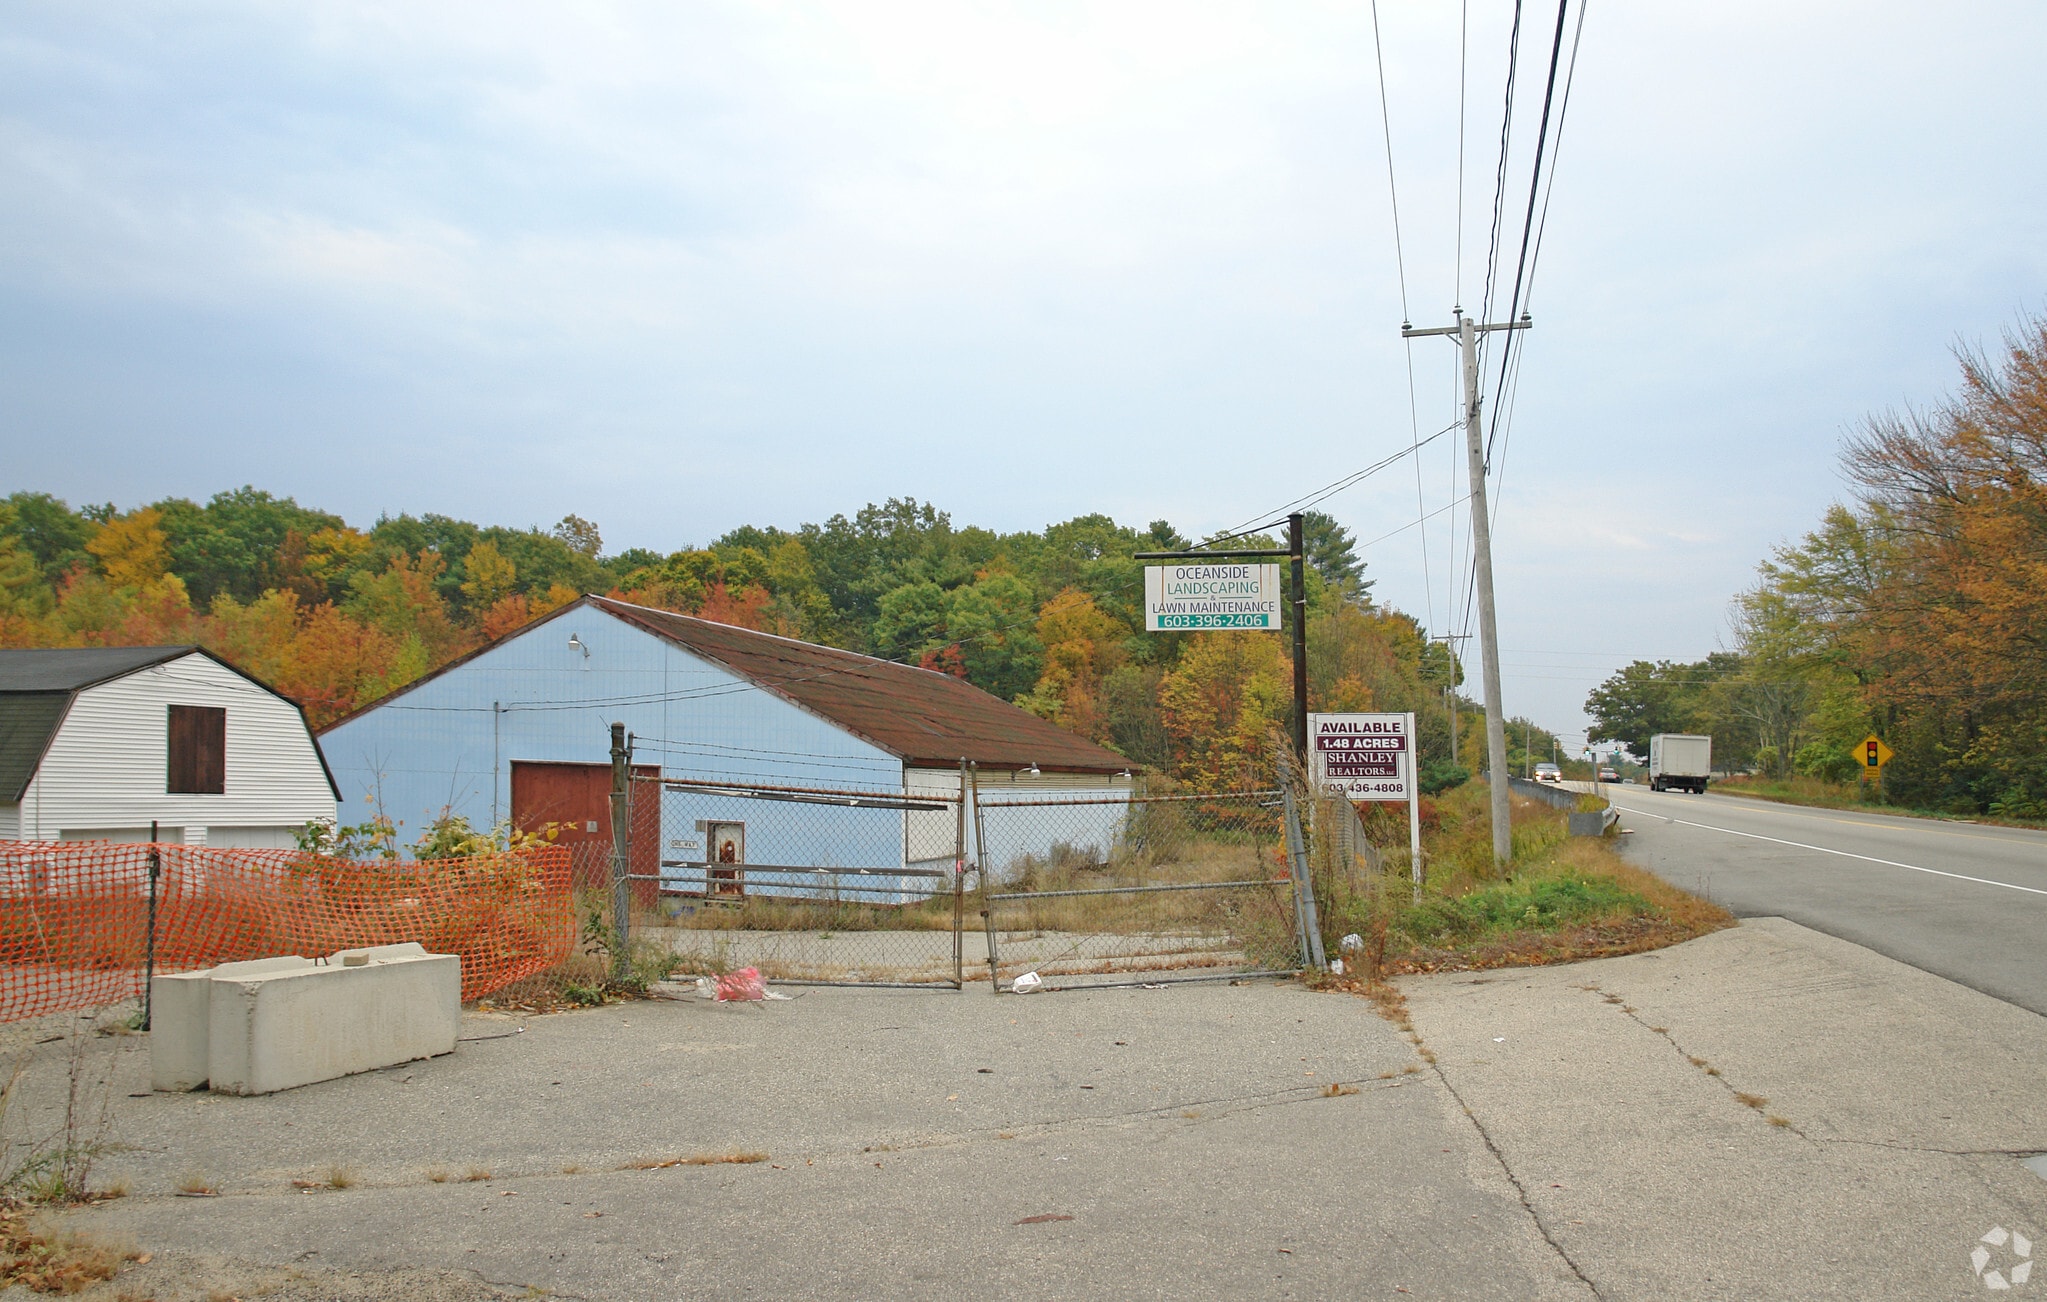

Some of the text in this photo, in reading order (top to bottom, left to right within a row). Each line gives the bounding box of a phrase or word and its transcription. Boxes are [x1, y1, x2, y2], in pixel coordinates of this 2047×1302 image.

[1176, 566, 1249, 580] OCEANSIDE
[1167, 581, 1259, 595] LANDSCAPING
[1152, 601, 1275, 613] LAWN MAINTENANCE
[1321, 722, 1401, 733] AVAILABLE
[1323, 738, 1399, 749] 1.48 ACRES
[1328, 752, 1394, 763] SHANLEY
[1329, 767, 1385, 775] REALTORS
